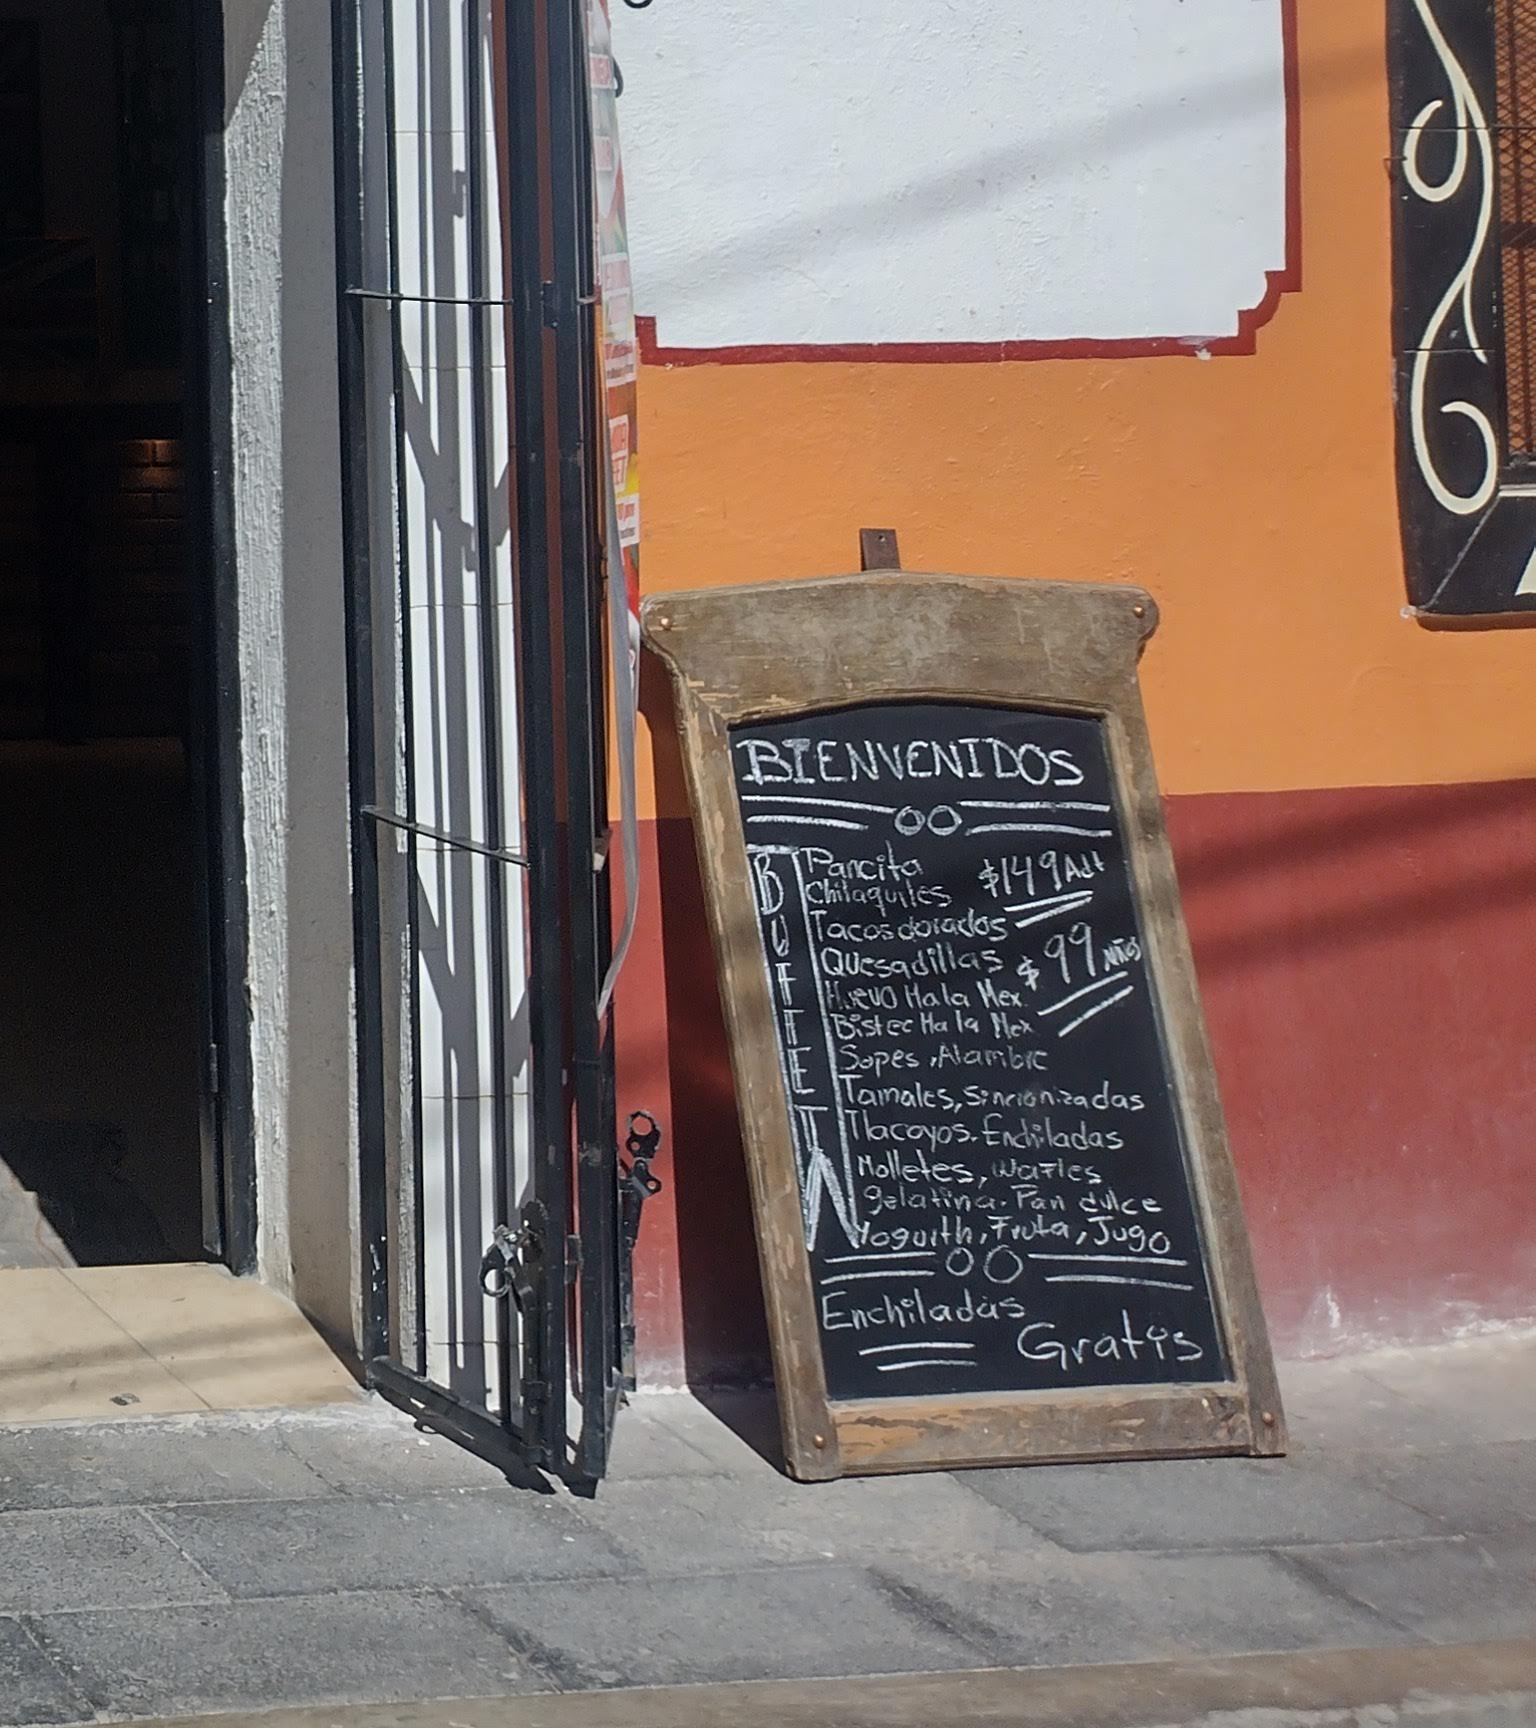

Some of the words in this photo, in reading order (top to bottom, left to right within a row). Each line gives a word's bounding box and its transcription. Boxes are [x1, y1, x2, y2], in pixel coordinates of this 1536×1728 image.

[736, 737, 1085, 787] BIENVENIDOS
[800, 840, 924, 881] Pancita
[820, 942, 1004, 980] Quesadillas
[829, 1012, 915, 1041] Bistec
[1010, 1183, 1067, 1212] Pan
[1086, 1214, 1172, 1255] Jugo
[819, 1287, 1026, 1332] Enchiladas
[1016, 1308, 1203, 1372] Gratis
